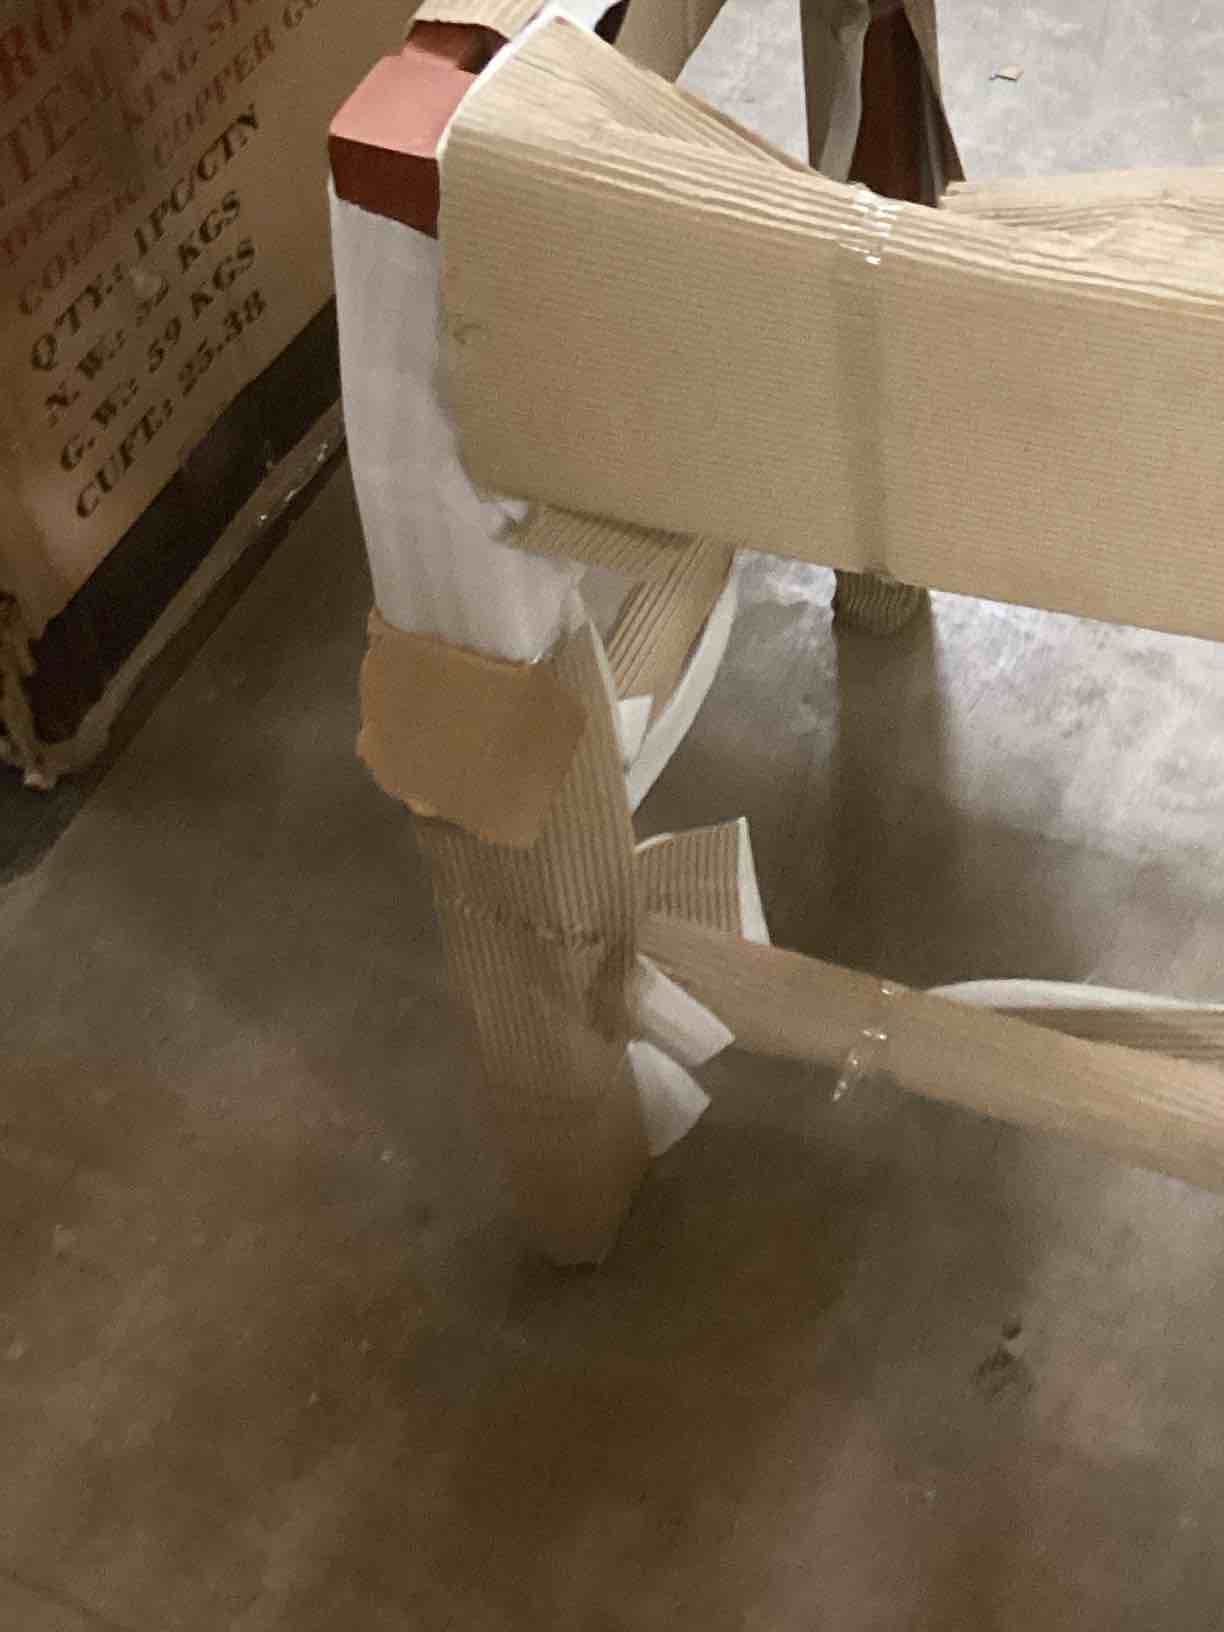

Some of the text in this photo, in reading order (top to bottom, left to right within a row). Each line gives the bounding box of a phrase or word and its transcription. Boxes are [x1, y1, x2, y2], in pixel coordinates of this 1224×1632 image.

[153, 27, 274, 169] COPPER
[134, 104, 258, 260] 1PC/CTN
[178, 191, 240, 274] KGS
[148, 317, 182, 373] 59
[190, 240, 255, 320] KGS
